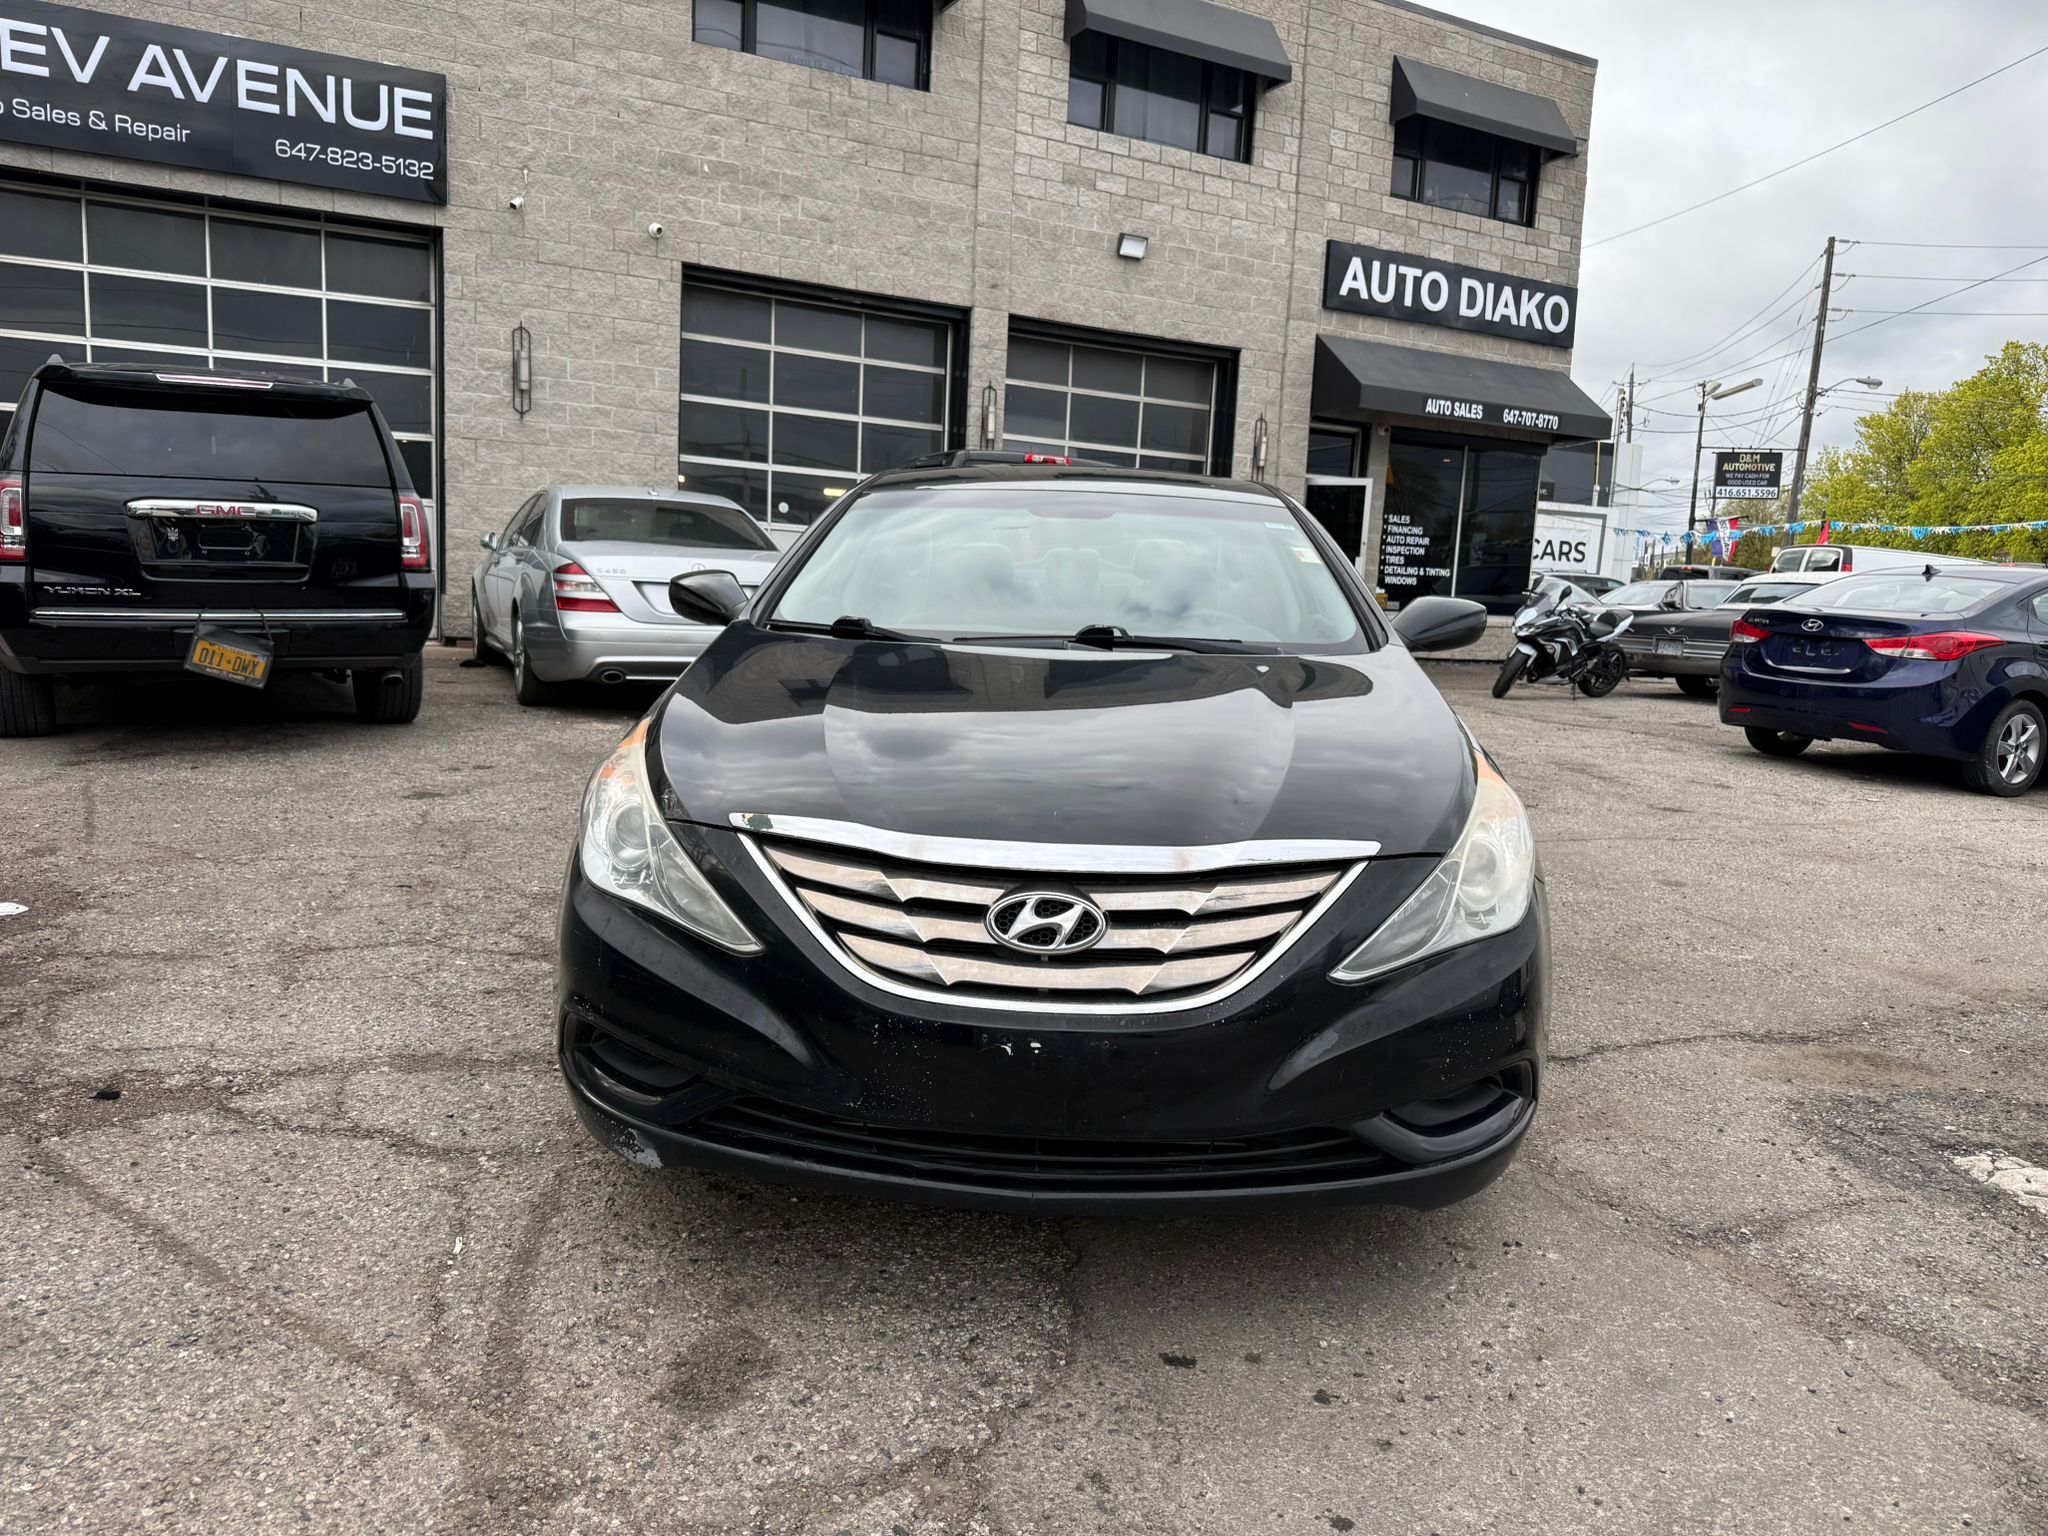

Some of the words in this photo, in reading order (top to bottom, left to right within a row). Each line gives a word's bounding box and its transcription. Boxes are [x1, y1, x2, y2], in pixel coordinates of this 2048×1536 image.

[127, 44, 433, 140] AVENUE
[12, 98, 81, 127] Sales
[88, 110, 108, 131] &
[115, 114, 191, 143] Repair
[275, 139, 434, 180] 647-823-5132
[1339, 256, 1449, 312] AUTO
[1459, 277, 1569, 333] DIAKO
[1425, 398, 1452, 416] AUTO
[1453, 401, 1483, 419] SALES
[1503, 408, 1559, 430] 647-707-8770
[1739, 454, 1760, 463] D&M
[1723, 463, 1775, 471] AUTOMOTIVE
[1717, 488, 1776, 498] 416.651.5596
[195, 504, 256, 518] GMC
[1388, 514, 1411, 524] SALES
[1387, 524, 1424, 535] FINANCING
[1386, 534, 1405, 544] AUTO
[1406, 536, 1430, 546] REPAIR
[1385, 545, 1425, 555] INSPECTION
[1385, 555, 1405, 565] TIRES
[1384, 565, 1418, 576] DETAILING
[1419, 567, 1425, 576] &
[1425, 567, 1451, 577] TINTING
[1384, 575, 1417, 586] WINDOWS
